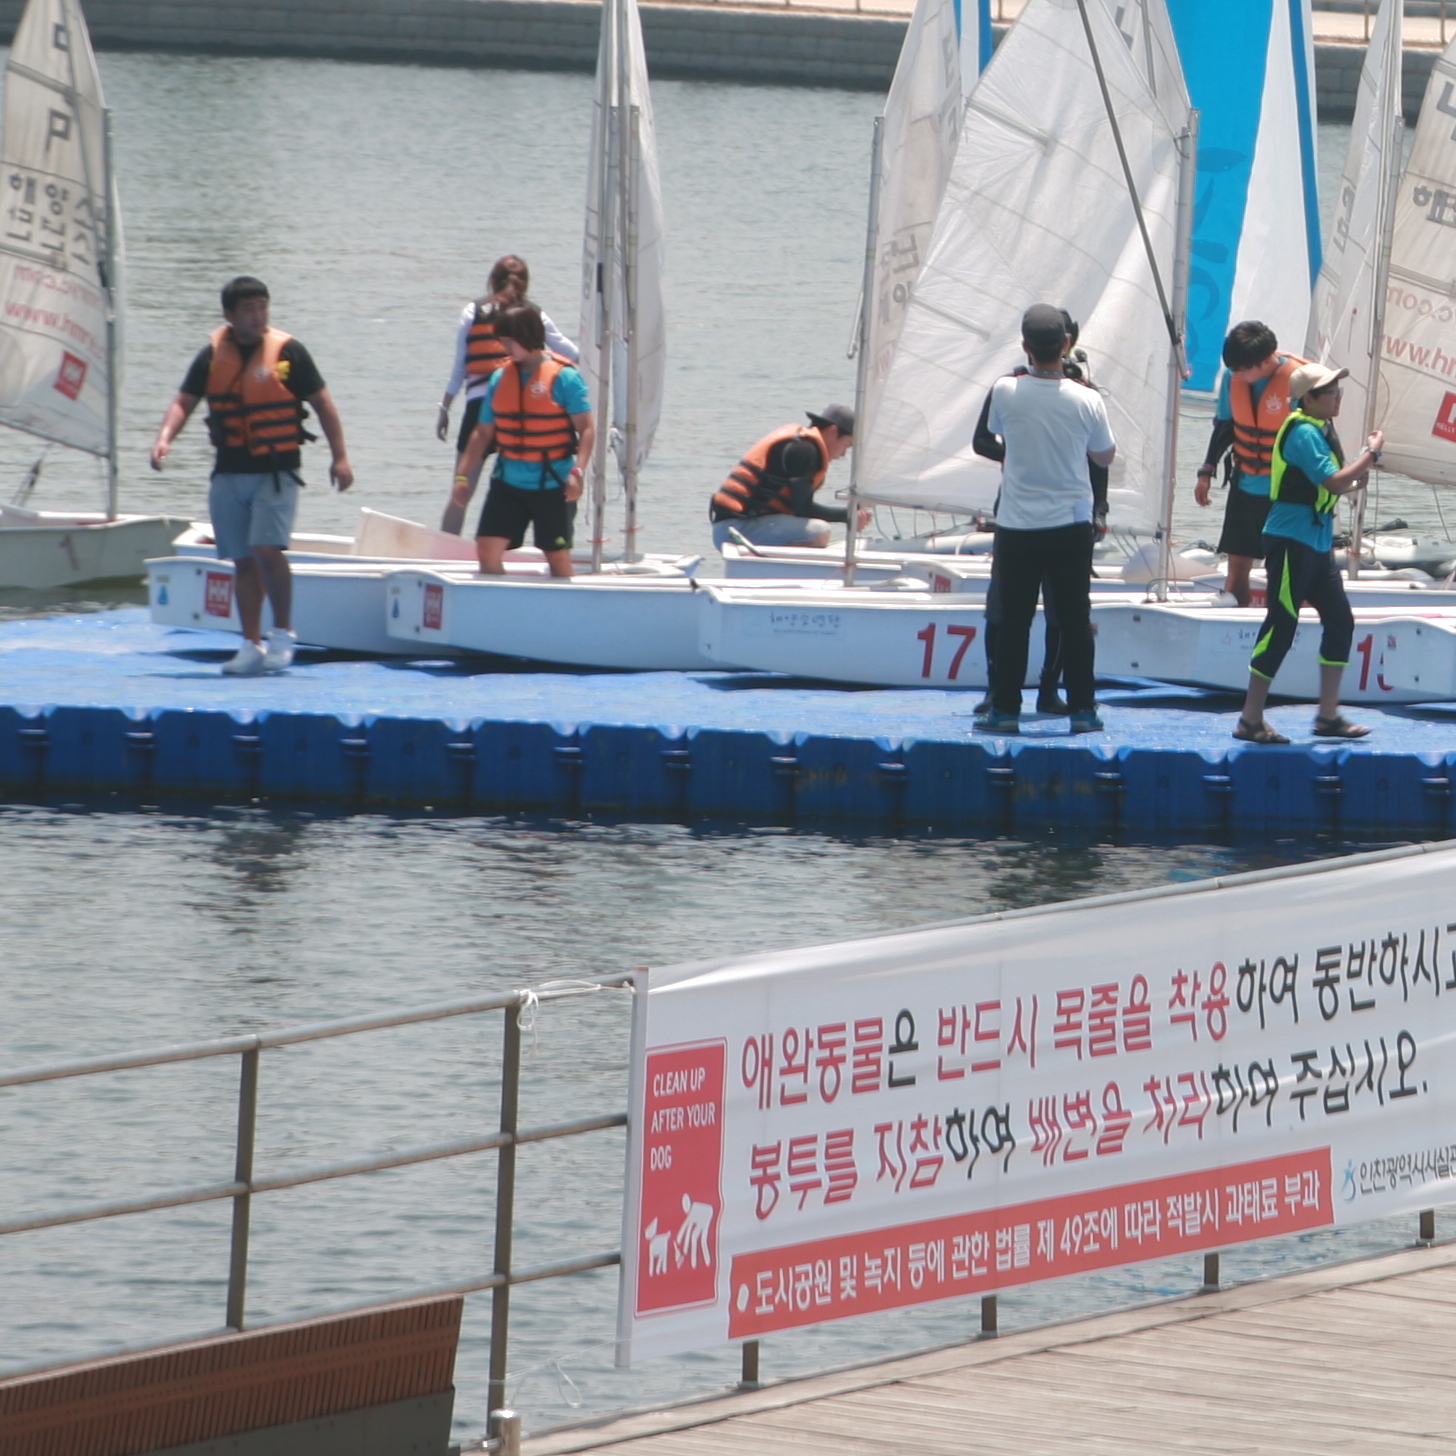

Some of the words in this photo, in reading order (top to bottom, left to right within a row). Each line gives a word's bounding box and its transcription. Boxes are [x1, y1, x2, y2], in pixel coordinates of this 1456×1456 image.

[917, 622, 977, 680] 17
[742, 1008, 919, 1110] 애완동물은
[937, 994, 1038, 1081] 반드시
[1053, 974, 1152, 1060] 목줄을
[1168, 953, 1300, 1041] 착용하여
[653, 1070, 687, 1098] CLEAN
[690, 1067, 706, 1093] UP
[651, 1106, 684, 1134] AFTER
[687, 1102, 716, 1127] YOUR
[750, 1128, 858, 1220] 봉투를
[874, 1102, 1016, 1194] 지참하여
[1028, 1080, 1133, 1166] 배변을
[1143, 1057, 1280, 1145] 처리하여
[1290, 1030, 1429, 1121] 주십시오.
[650, 1145, 672, 1171] DOG
[755, 1259, 832, 1315] 도시공원
[839, 1254, 858, 1302] 및
[864, 1246, 902, 1294] 녹지
[908, 1239, 945, 1289] 등에
[952, 1230, 990, 1280] 관한
[995, 1223, 1031, 1272] 법률
[1037, 1218, 1055, 1263] 제
[1060, 1206, 1119, 1256] 49조에
[1124, 1198, 1162, 1245] 따라
[1166, 1188, 1220, 1238] 적발시
[1226, 1176, 1279, 1227] 과태료
[1284, 1169, 1321, 1216] 부과
